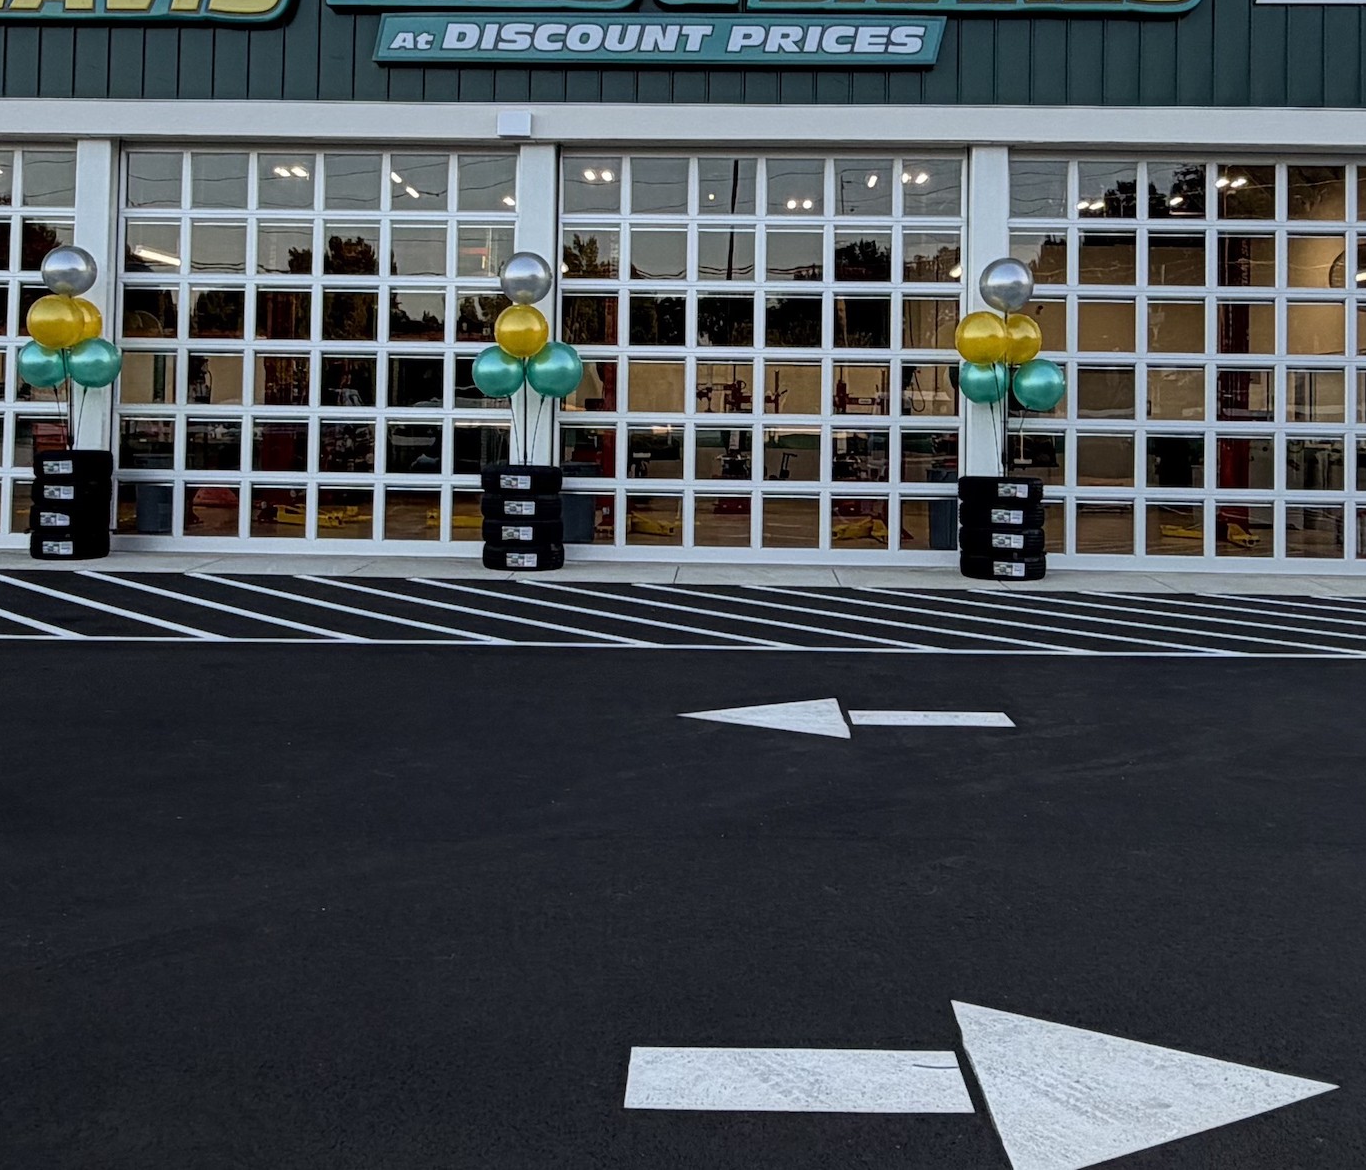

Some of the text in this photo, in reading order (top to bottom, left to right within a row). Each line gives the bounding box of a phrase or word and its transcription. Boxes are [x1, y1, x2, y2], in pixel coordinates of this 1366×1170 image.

[388, 22, 927, 54] At DISCOUNT PRICES
